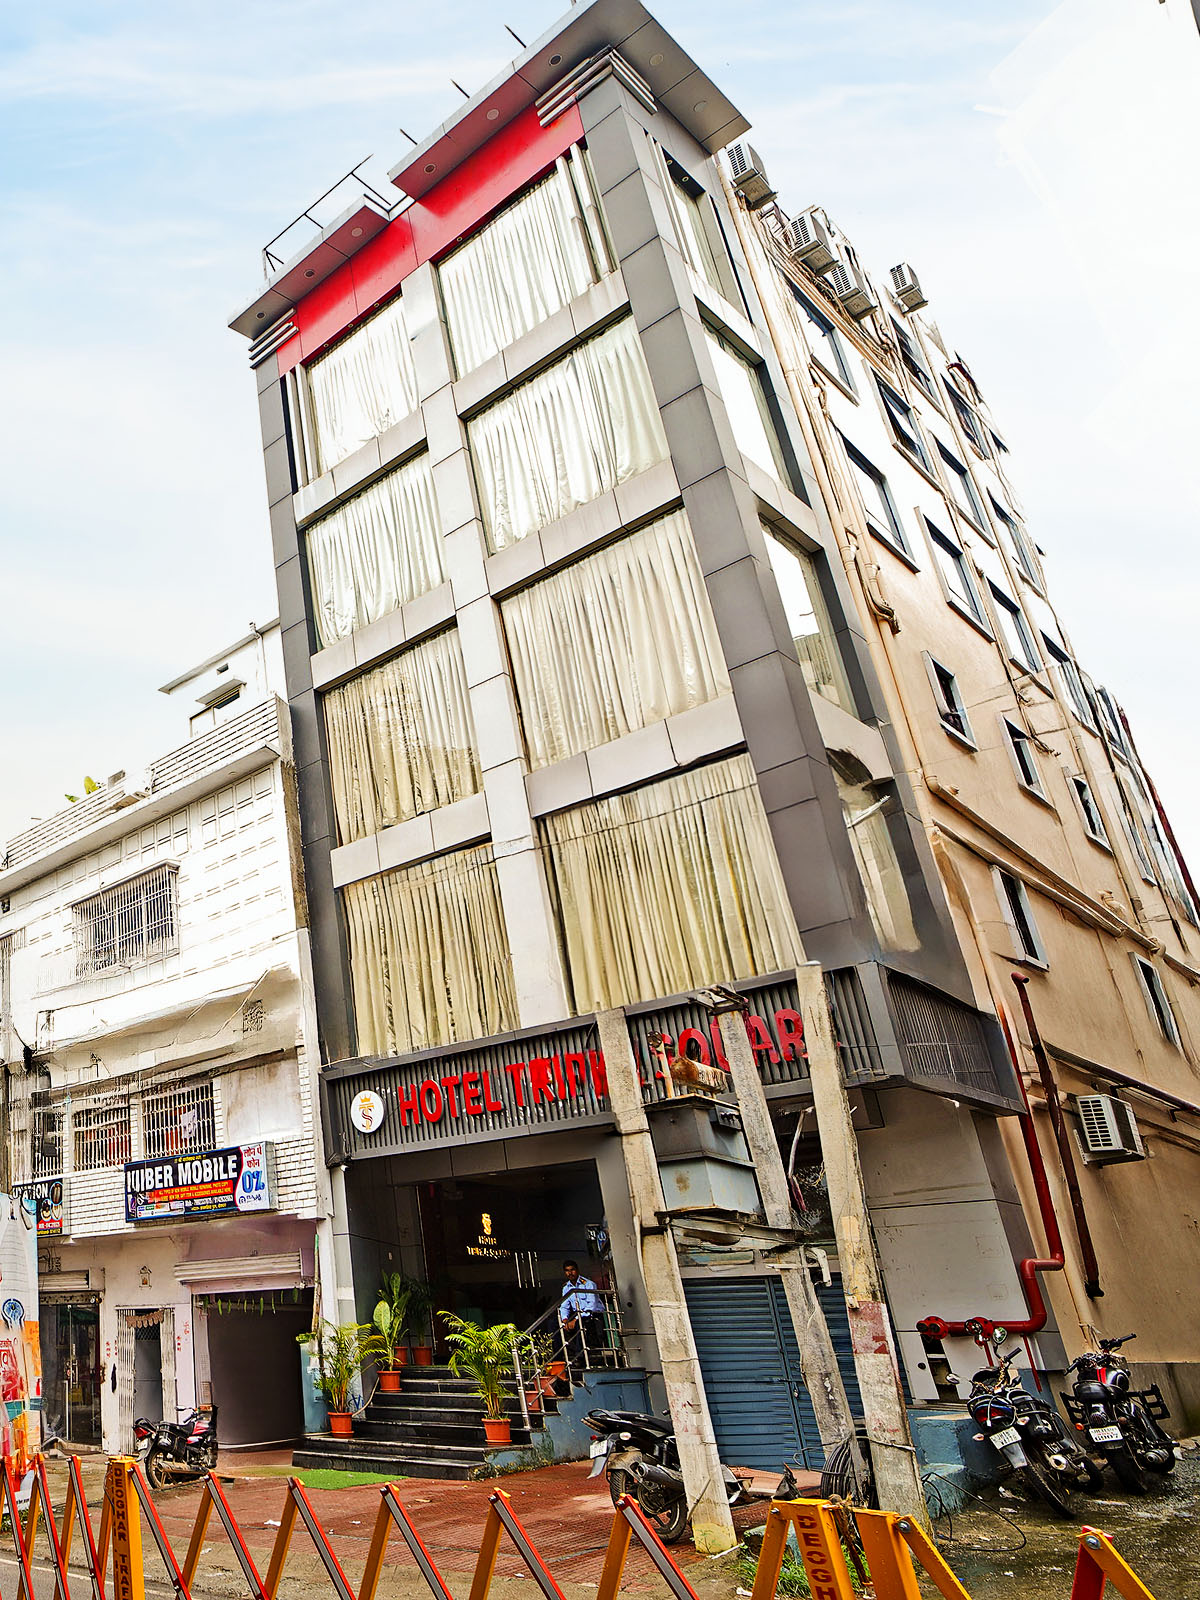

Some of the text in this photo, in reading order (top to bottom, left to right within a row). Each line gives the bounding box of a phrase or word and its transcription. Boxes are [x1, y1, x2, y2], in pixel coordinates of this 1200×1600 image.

[398, 1071, 502, 1126] HOTEL
[178, 1155, 238, 1186] MOBILE
[241, 1170, 266, 1194] 0%
[114, 1468, 130, 1600] DEOGHAR TRAF
[797, 1515, 838, 1600] DEOGH
